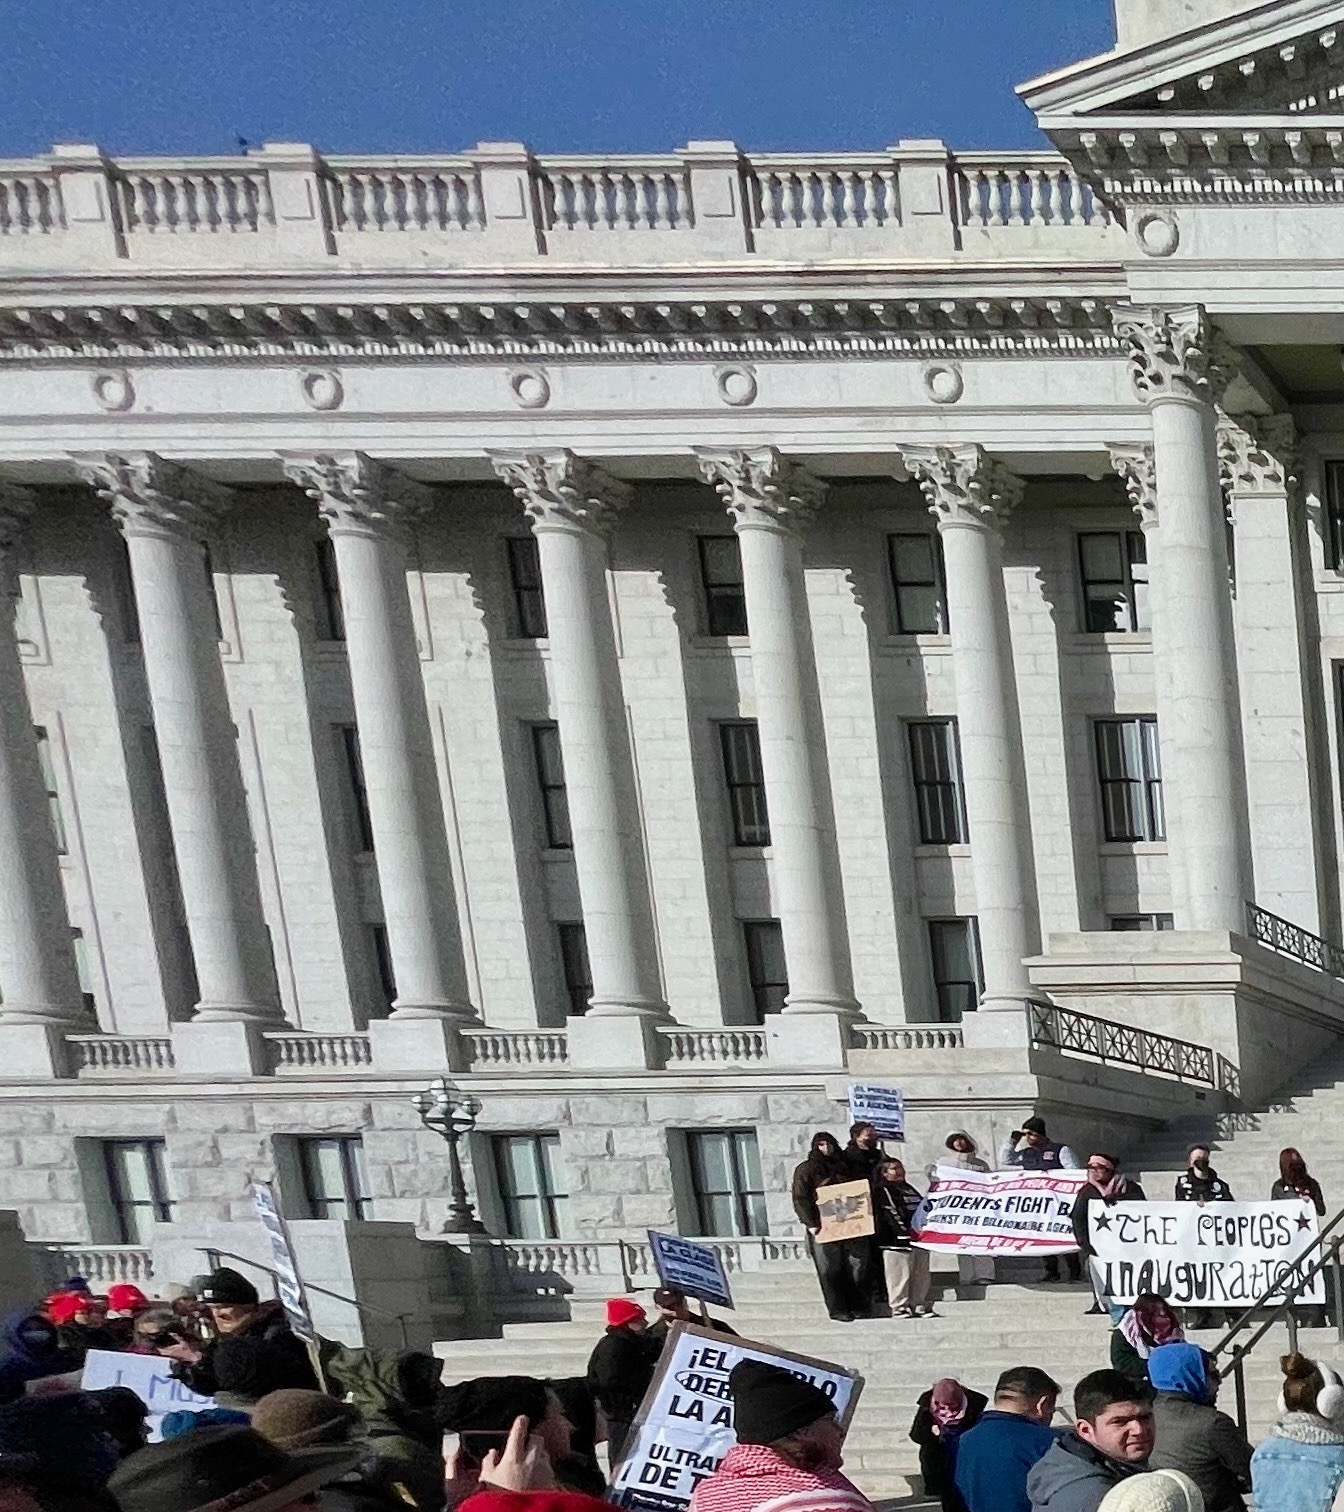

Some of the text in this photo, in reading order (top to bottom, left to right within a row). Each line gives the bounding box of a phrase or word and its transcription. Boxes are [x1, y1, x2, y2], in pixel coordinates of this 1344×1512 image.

[1005, 1195, 1054, 1215] FIGHT
[962, 1215, 980, 1226] THE
[668, 1395, 704, 1422] LA
[649, 1443, 720, 1472] ULTRA
[638, 1462, 682, 1489] DE
